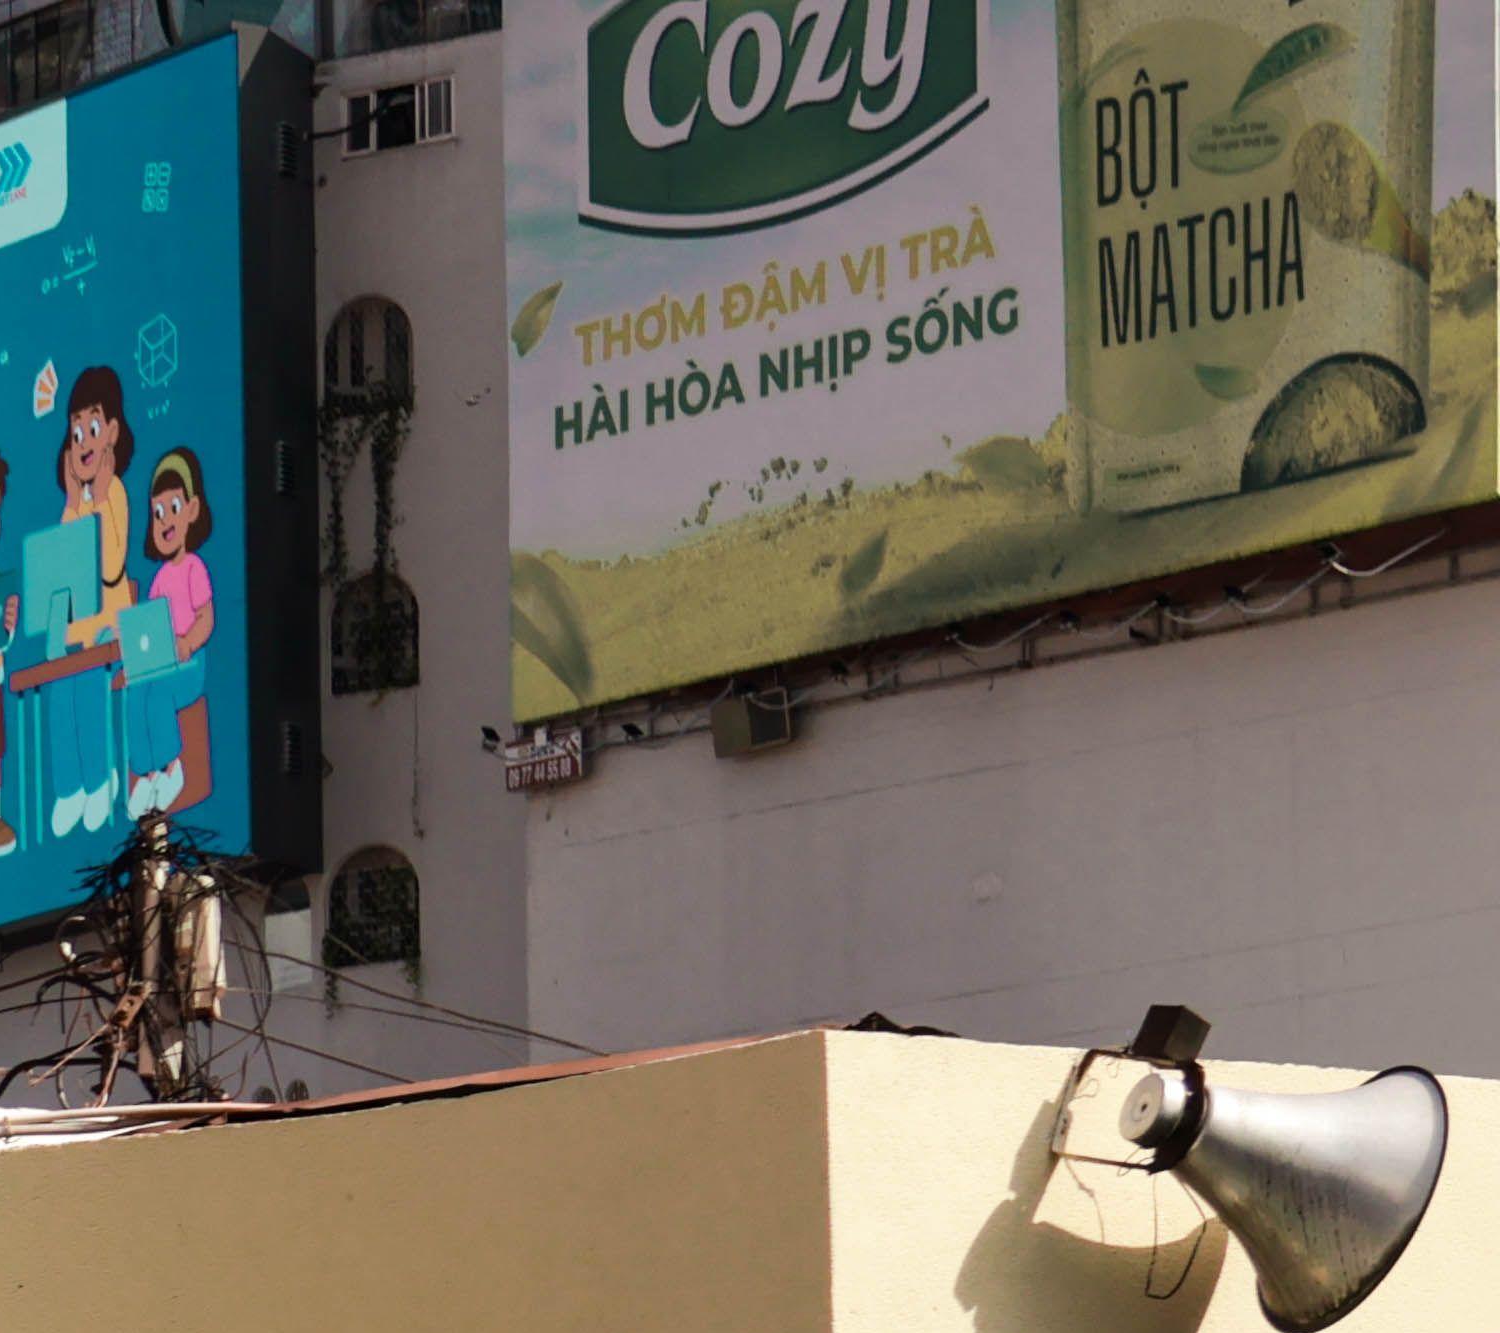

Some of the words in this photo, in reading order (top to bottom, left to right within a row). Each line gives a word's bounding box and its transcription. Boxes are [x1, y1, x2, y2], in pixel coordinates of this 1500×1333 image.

[623, 0, 929, 150] Cozy
[1096, 68, 1189, 210] BỘT
[575, 293, 707, 367] THƠM
[719, 262, 827, 333] ĐẬM
[841, 245, 887, 302] VỊ
[900, 205, 996, 281] TRÀ
[1098, 190, 1306, 348] MATCHA
[554, 384, 630, 450] HÀI
[645, 360, 746, 427] HÒA
[759, 328, 872, 393] NHỊP
[886, 287, 1020, 364] SỐNG
